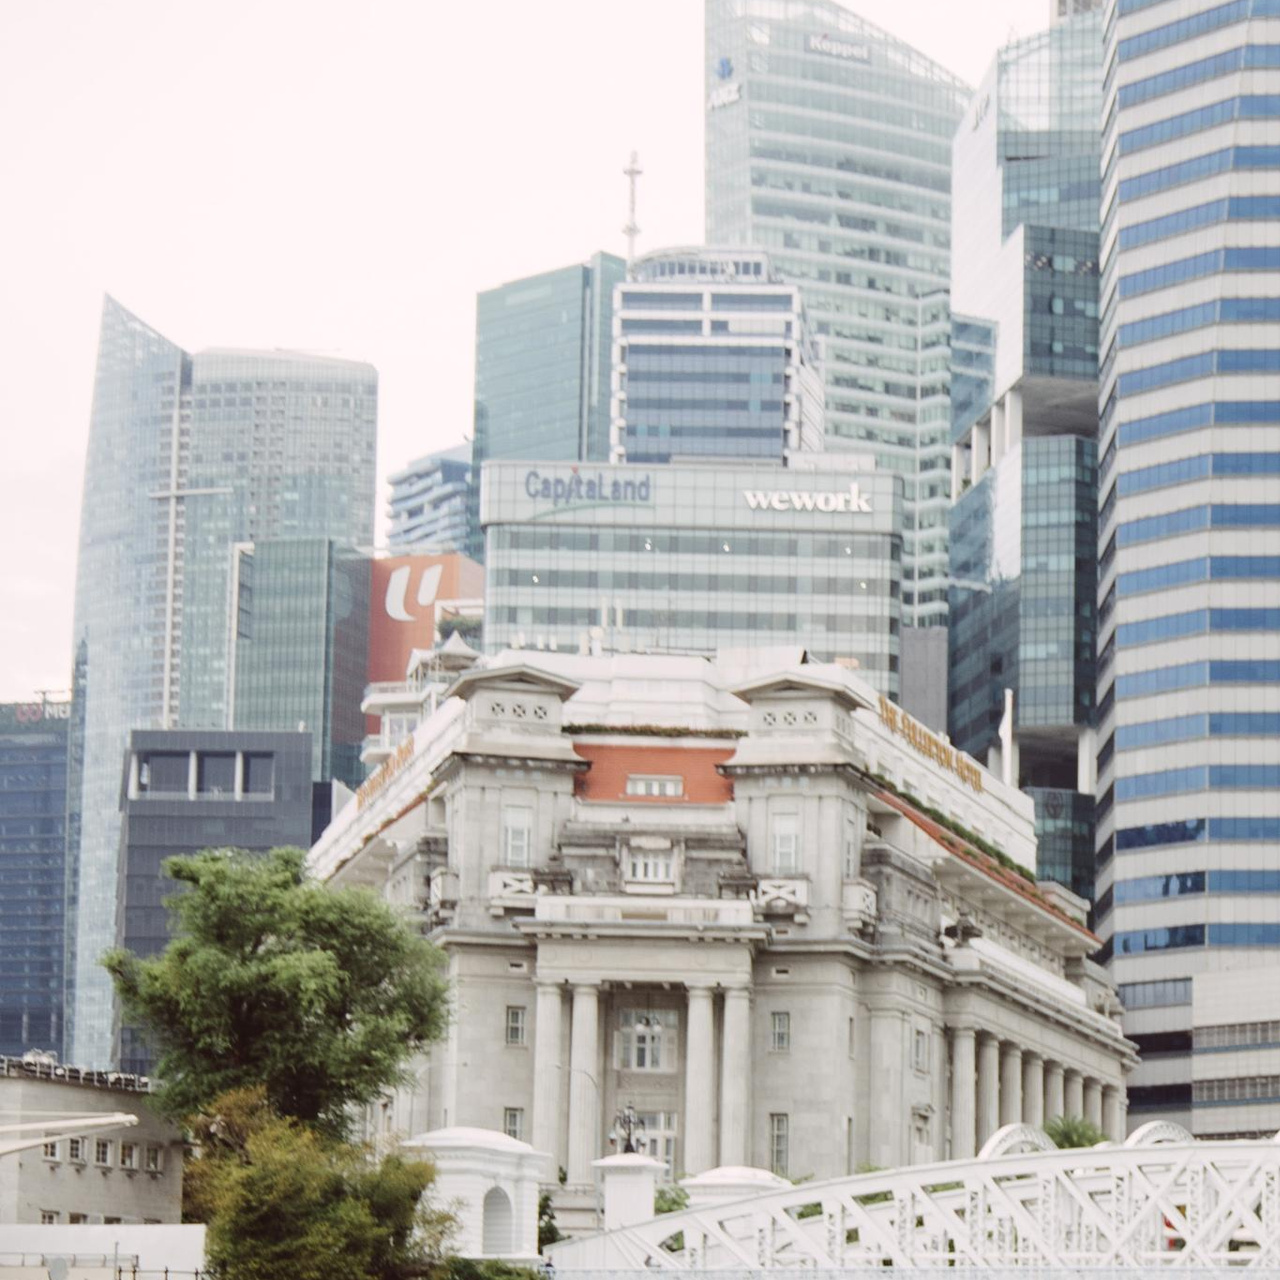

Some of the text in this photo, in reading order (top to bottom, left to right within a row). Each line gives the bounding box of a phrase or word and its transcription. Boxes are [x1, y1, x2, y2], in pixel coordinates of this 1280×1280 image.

[810, 34, 868, 59] Keppel
[525, 466, 650, 506] CapitaLand
[743, 482, 873, 513] wework
